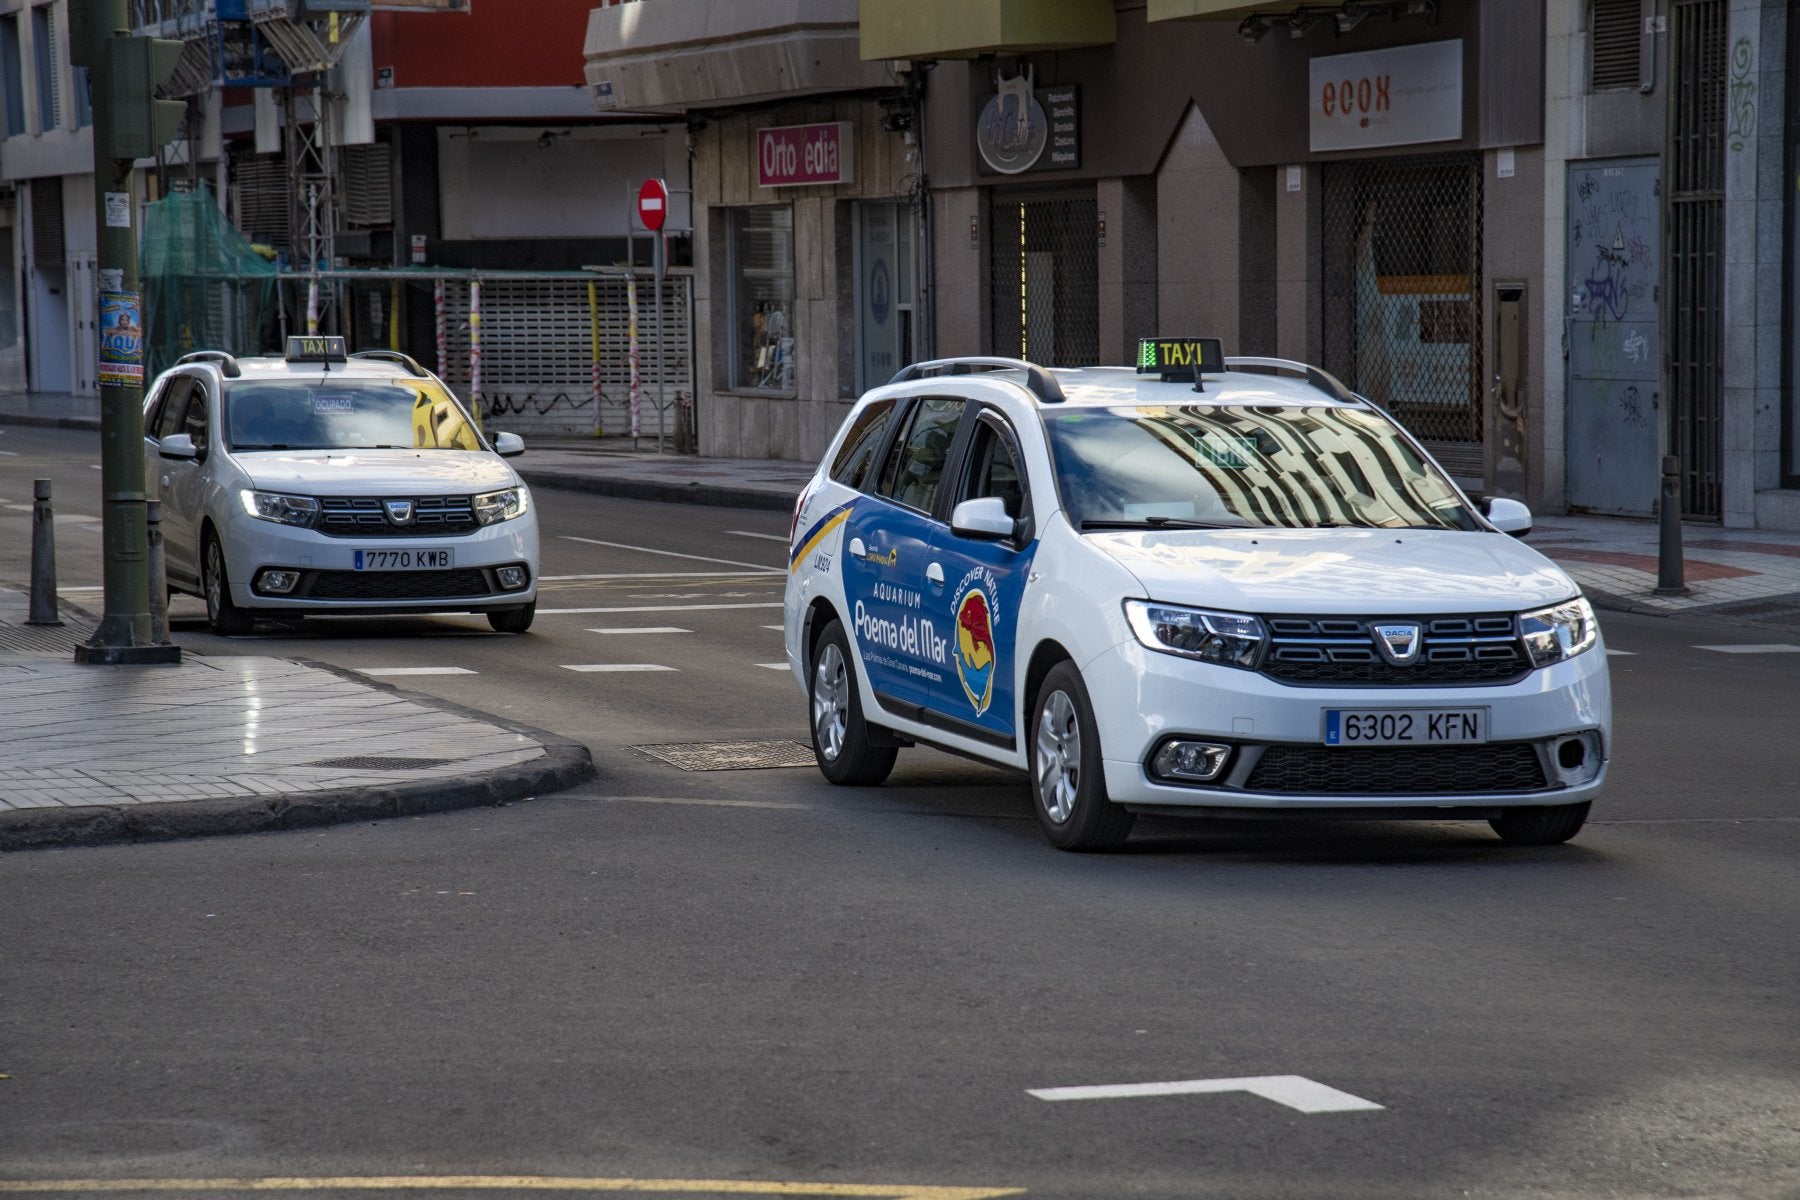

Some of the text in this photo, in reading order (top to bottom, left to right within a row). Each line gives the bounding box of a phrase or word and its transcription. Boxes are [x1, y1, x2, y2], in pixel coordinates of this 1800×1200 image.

[1322, 75, 1390, 117] ecox
[301, 338, 328, 354] TAXI
[1159, 343, 1202, 365] TAXI
[315, 399, 352, 410] OCUPADO
[367, 552, 410, 568] 7770
[416, 551, 449, 567] KWB
[873, 582, 920, 609] AQUARIUM
[951, 566, 1000, 626] DISCOVER NATURE
[855, 600, 947, 664] Poema del Mar
[1346, 713, 1477, 741] 6302 KFN
